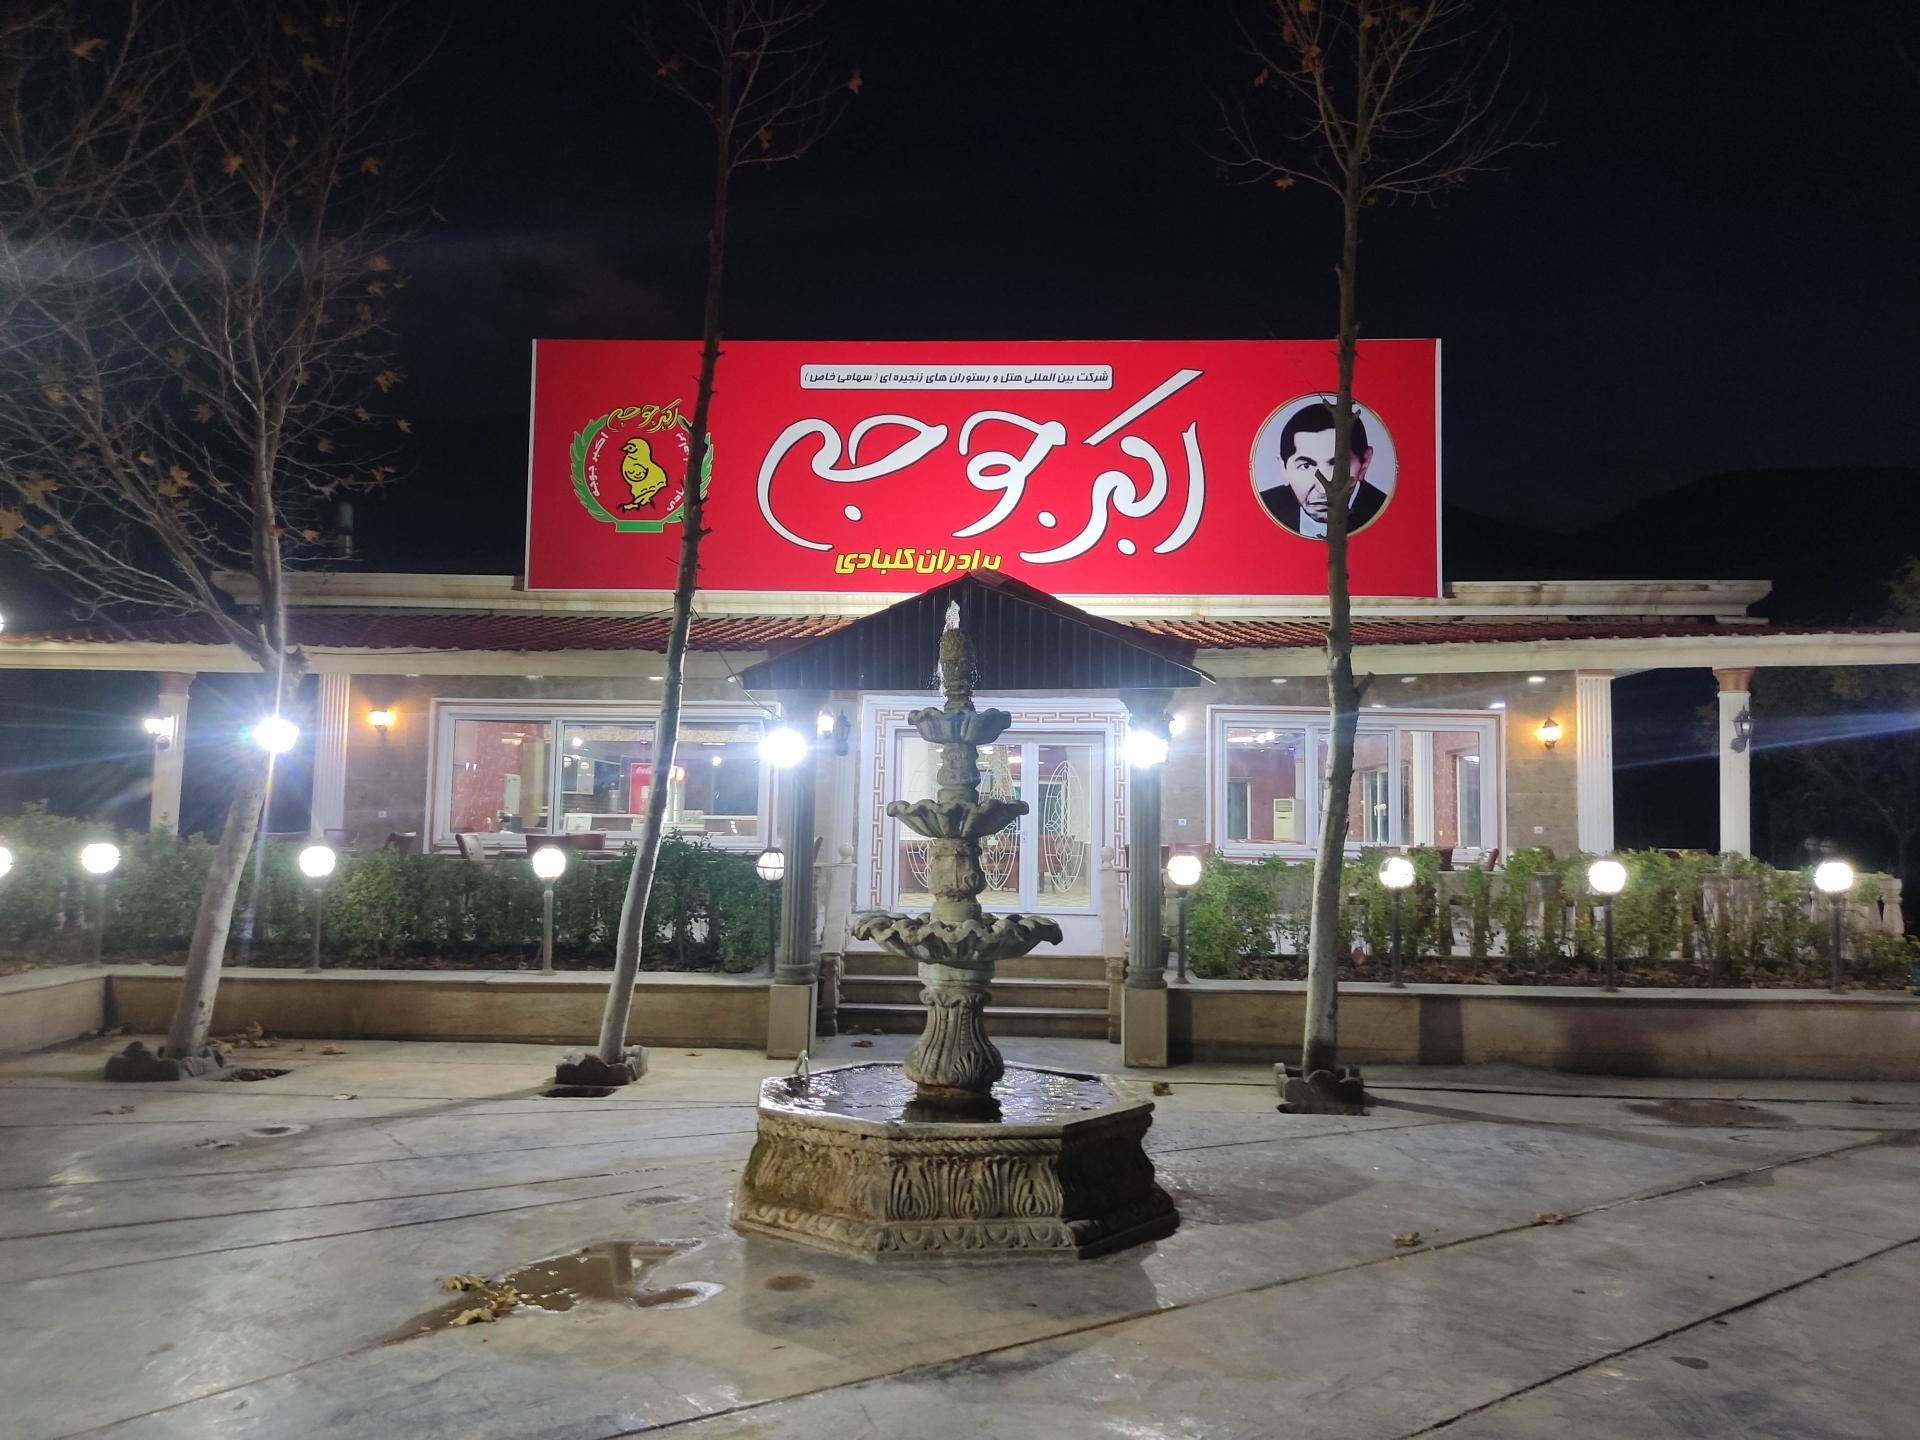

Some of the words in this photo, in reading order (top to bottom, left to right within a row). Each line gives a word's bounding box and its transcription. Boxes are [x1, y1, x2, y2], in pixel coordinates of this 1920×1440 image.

[926, 372, 947, 384] های
[949, 372, 990, 384] رستوران
[993, 374, 998, 383] و
[1001, 372, 1022, 384] هتل
[1025, 372, 1056, 384] المللی
[1058, 373, 1074, 384] بین
[1077, 371, 1108, 382] شرکت
[606, 404, 660, 432] جوجه
[646, 398, 682, 433] اکبر
[1019, 369, 1205, 564] اکبر
[756, 409, 1066, 551] جوجه
